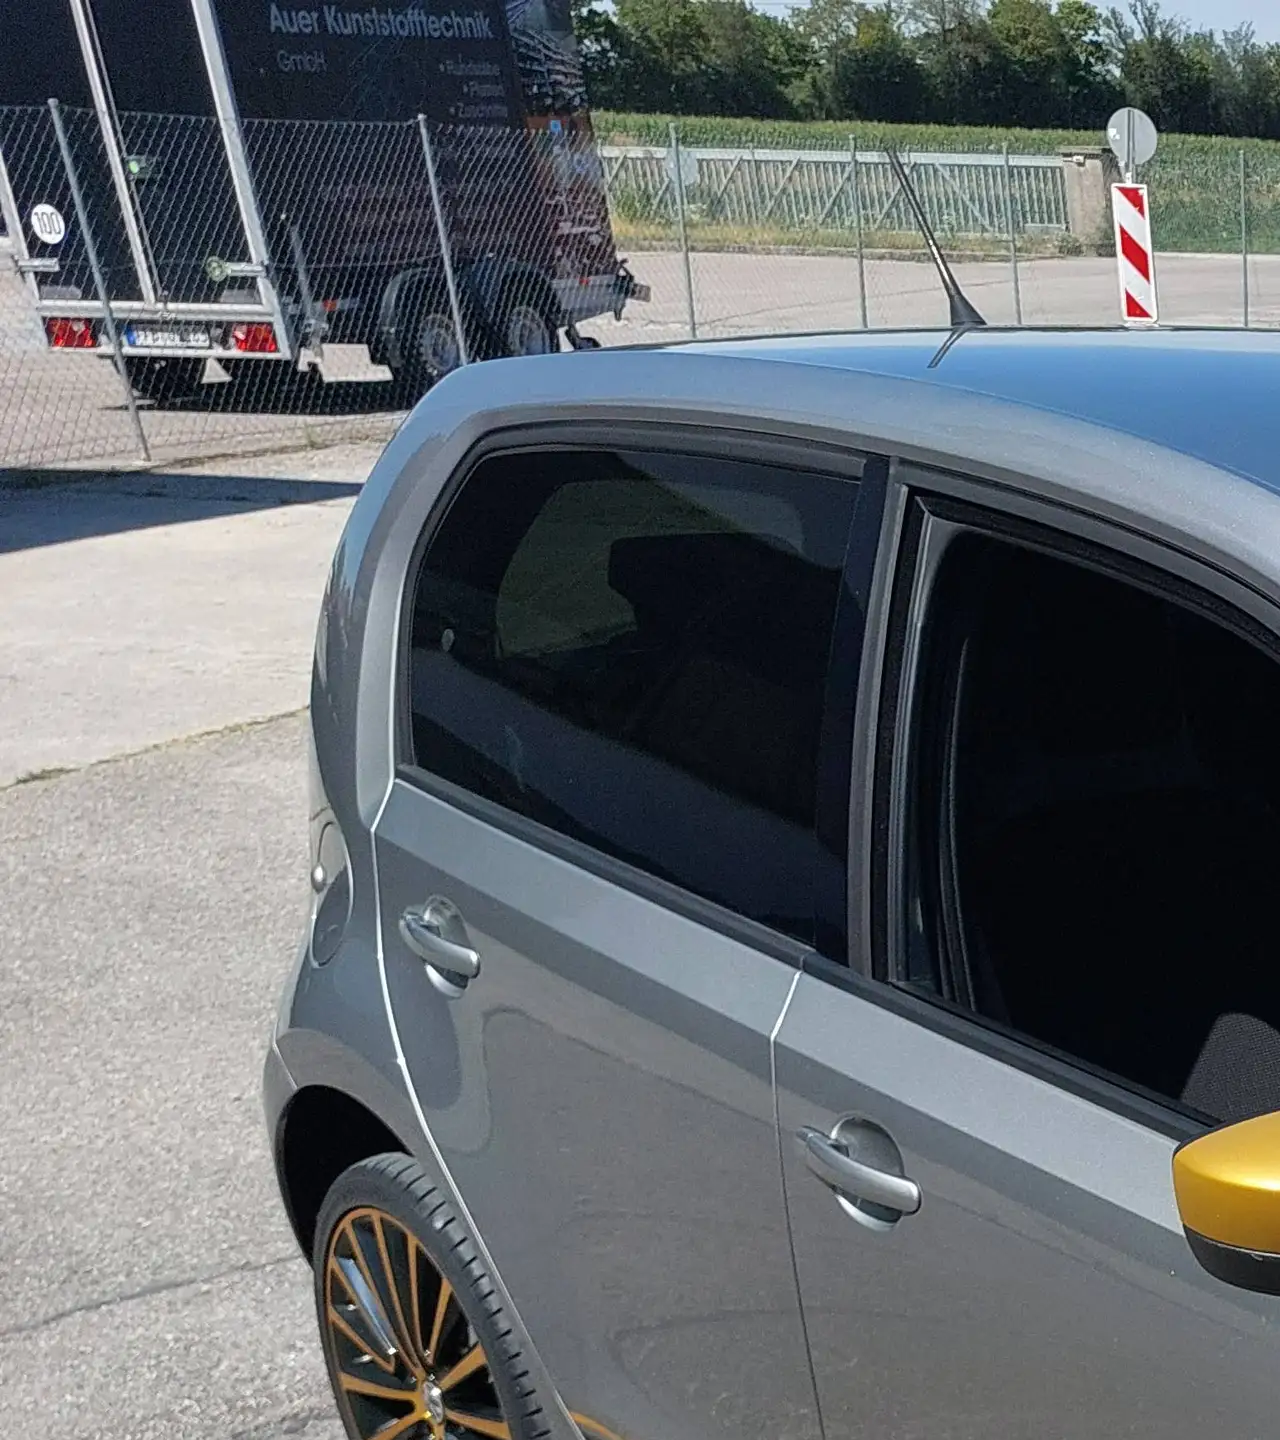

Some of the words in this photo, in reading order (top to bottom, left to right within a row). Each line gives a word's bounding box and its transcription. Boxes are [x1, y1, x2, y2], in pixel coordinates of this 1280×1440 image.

[269, 3, 319, 33] Auer
[323, 5, 494, 38] Kunststofftechnik
[276, 50, 328, 72] GmbH
[33, 211, 62, 235] 100
